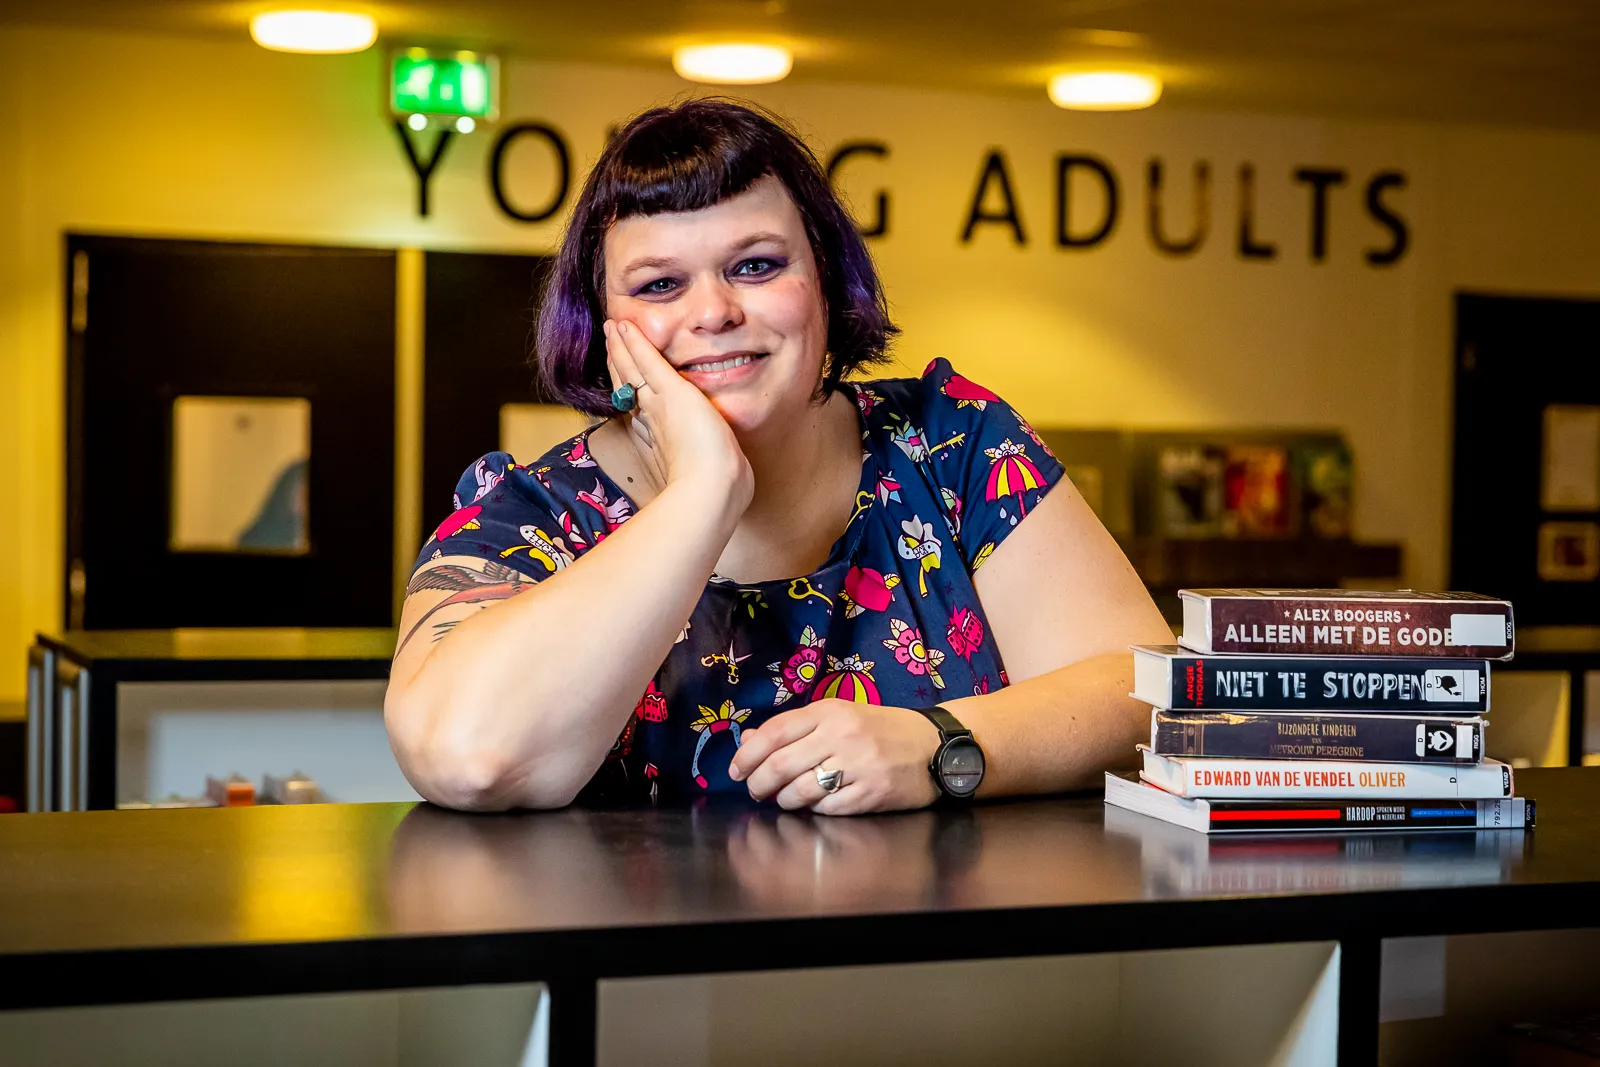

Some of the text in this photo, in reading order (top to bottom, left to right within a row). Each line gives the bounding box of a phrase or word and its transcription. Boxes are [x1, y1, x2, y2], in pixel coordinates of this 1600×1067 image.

[393, 118, 1412, 266] YOG ADULTS
[1294, 608, 1402, 623] ALEX BOOGERS
[1224, 623, 1456, 646] ALLEEN MET DE GODE
[1186, 665, 1195, 700] ANGIE
[1196, 659, 1204, 707] THOMAS
[1216, 670, 1425, 700] NIET TE STOPPEN
[1277, 722, 1357, 737] BIJZONDERE KINDEREN
[1316, 745, 1364, 757] PEREGRINE
[1194, 770, 1406, 787] EDWARD VAN DE VENDEL OLIVER
[1346, 806, 1376, 821] HARDOP
